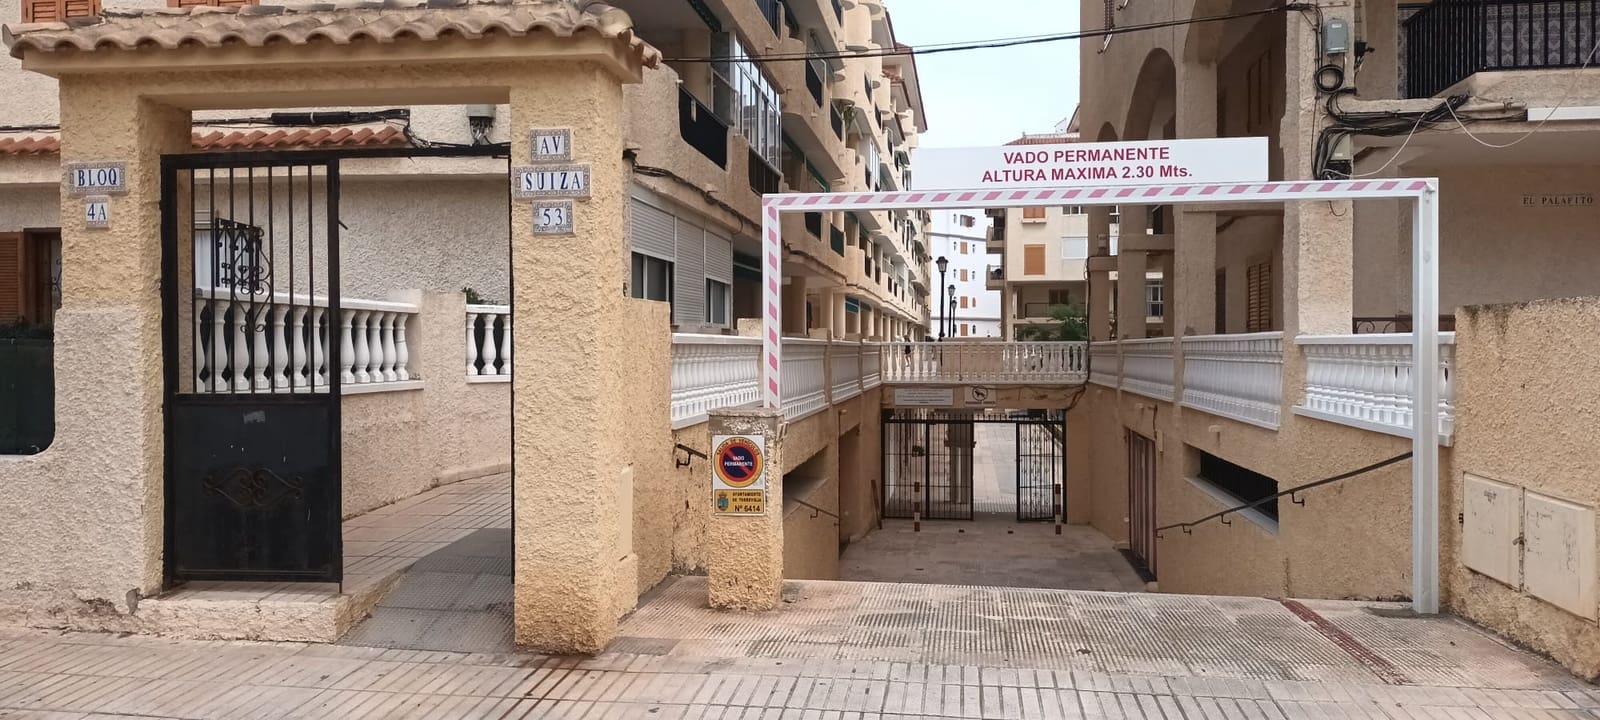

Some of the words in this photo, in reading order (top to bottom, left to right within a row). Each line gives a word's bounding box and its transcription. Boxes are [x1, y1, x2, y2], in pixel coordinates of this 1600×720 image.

[540, 136, 561, 154] AV
[1003, 151, 1049, 164] VADO
[1053, 147, 1170, 163] PERMANENTE
[78, 168, 117, 187] BLOQ
[525, 172, 581, 191] SUIZA
[981, 168, 1047, 183] ALTURA
[1050, 166, 1118, 181] MAXIMA
[1121, 165, 1155, 179] 2.30
[1158, 163, 1193, 178] Mts.
[1522, 196, 1535, 205] EL
[1541, 196, 1594, 205] PALAFITO
[87, 203, 106, 220] 4A
[543, 208, 563, 226] 53
